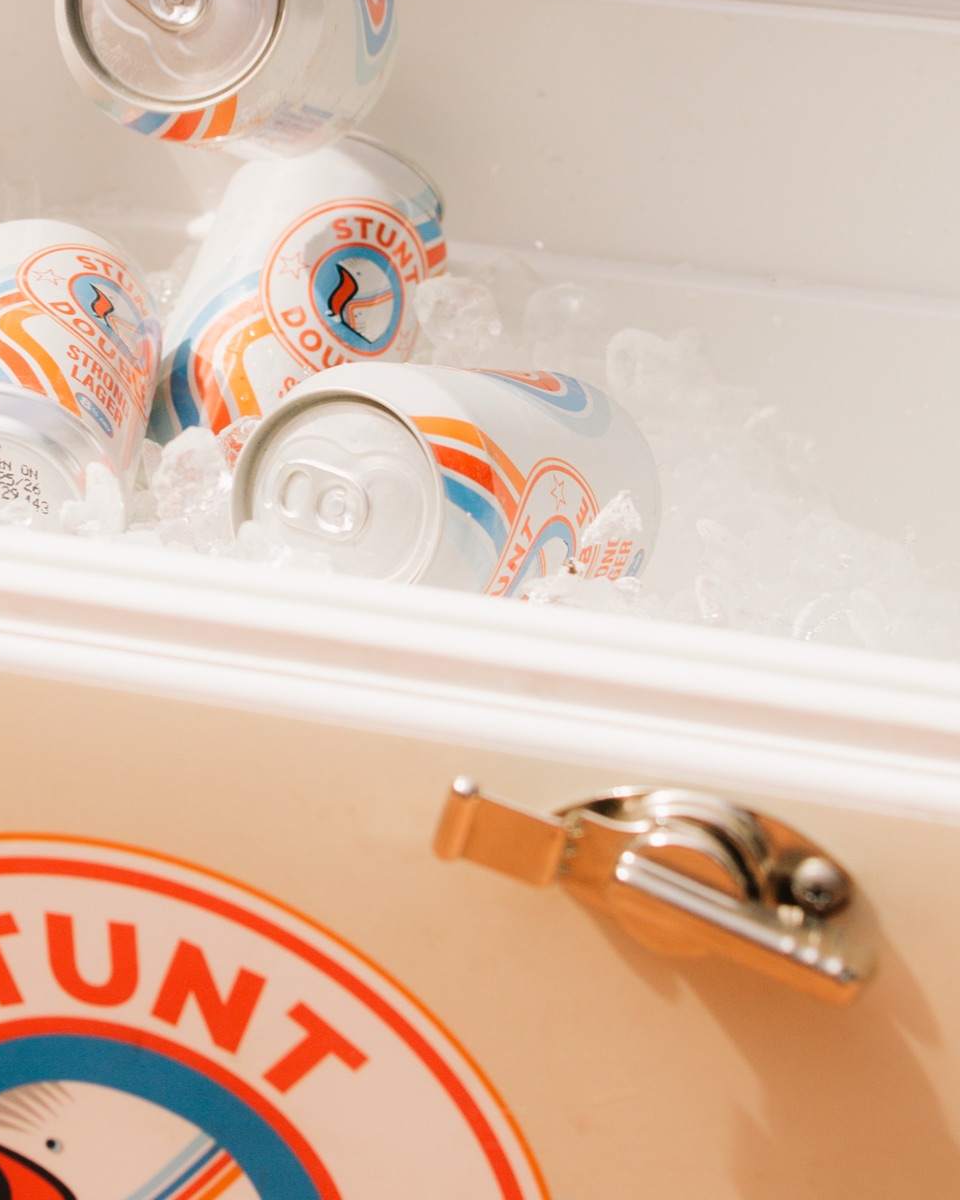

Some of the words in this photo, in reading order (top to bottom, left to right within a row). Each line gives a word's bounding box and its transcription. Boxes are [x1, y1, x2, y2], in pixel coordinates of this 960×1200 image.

[331, 216, 420, 285] STUNT
[76, 255, 150, 318] STUN
[280, 305, 356, 370] DOU
[71, 364, 123, 429] LAGER
[21, 464, 39, 481] ON
[490, 514, 534, 597] UNT
[607, 540, 633, 582] GER
